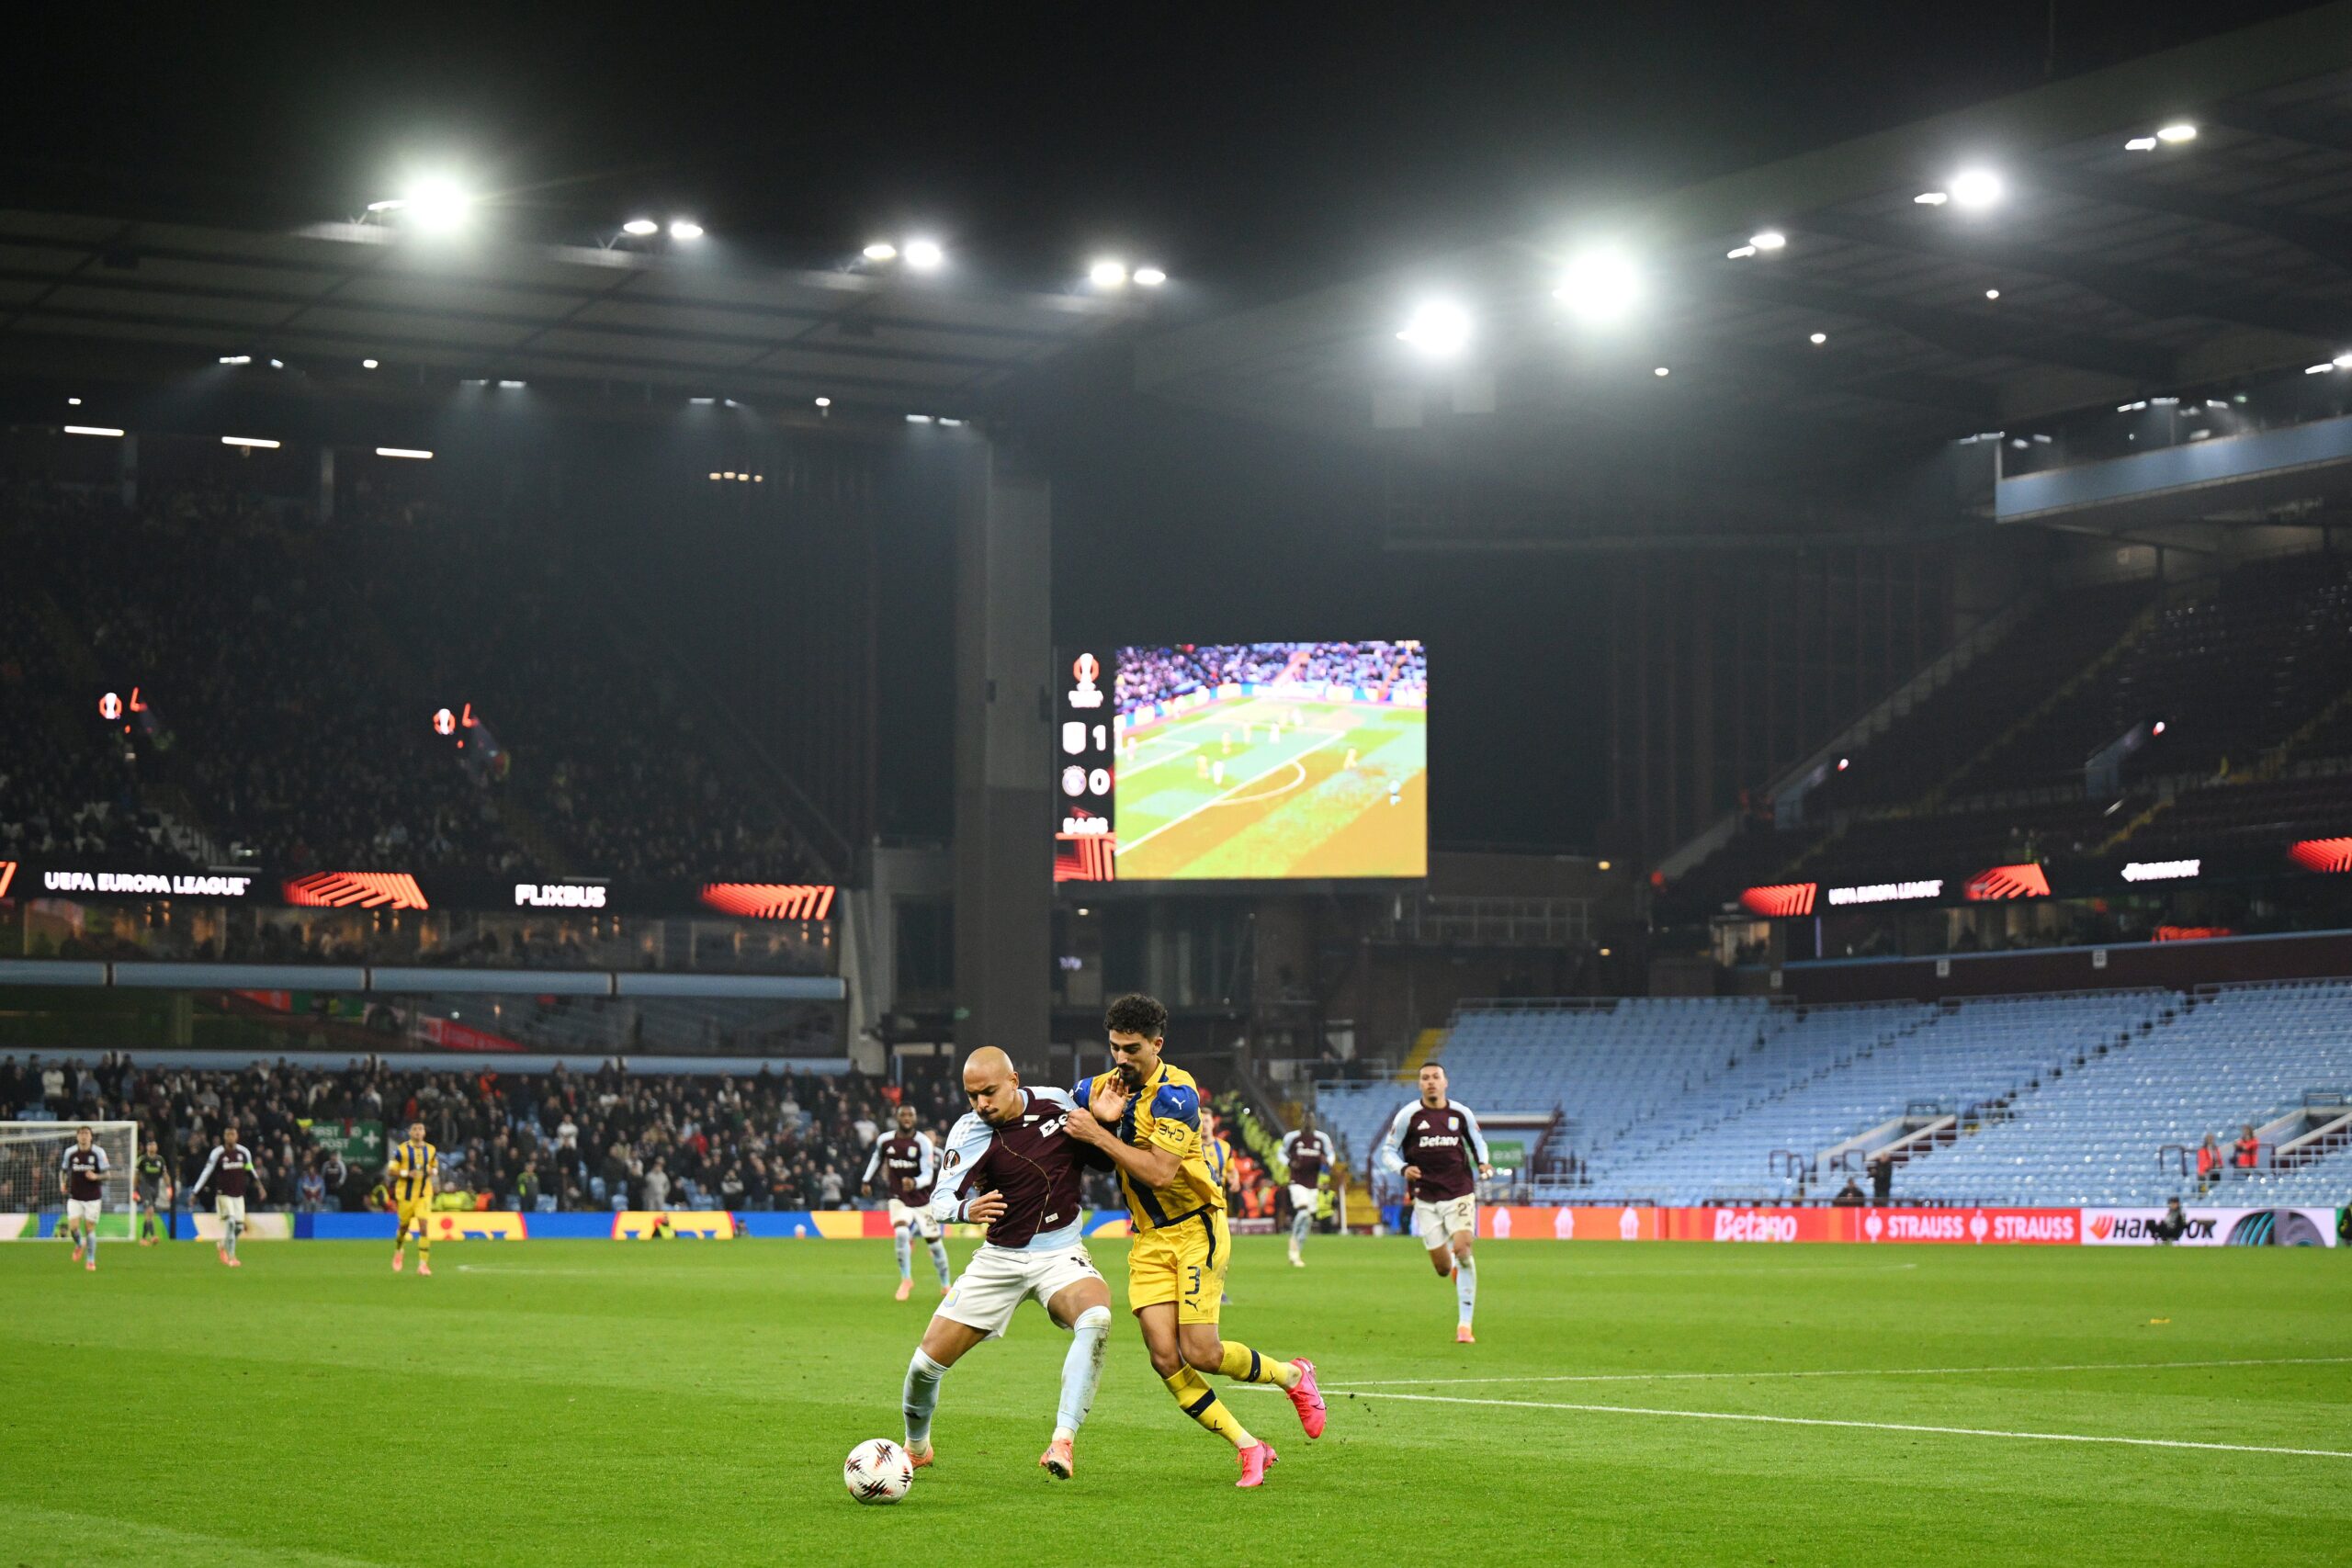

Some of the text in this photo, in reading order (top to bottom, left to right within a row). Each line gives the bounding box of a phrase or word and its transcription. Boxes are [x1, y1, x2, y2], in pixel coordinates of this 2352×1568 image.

[1092, 724, 1106, 751] 1
[1089, 768, 1111, 795] 0
[44, 871, 96, 891] UEFA
[97, 873, 172, 894] EUROPA
[514, 884, 606, 908] FLIXBUS
[1159, 1122, 1185, 1142] BYD
[1419, 1135, 1459, 1147] Betano
[1713, 1209, 1798, 1242] Betano
[1888, 1215, 1964, 1239] STRAUSS
[1994, 1216, 2074, 1239] STRAUSS
[1184, 1266, 1201, 1295] 3
